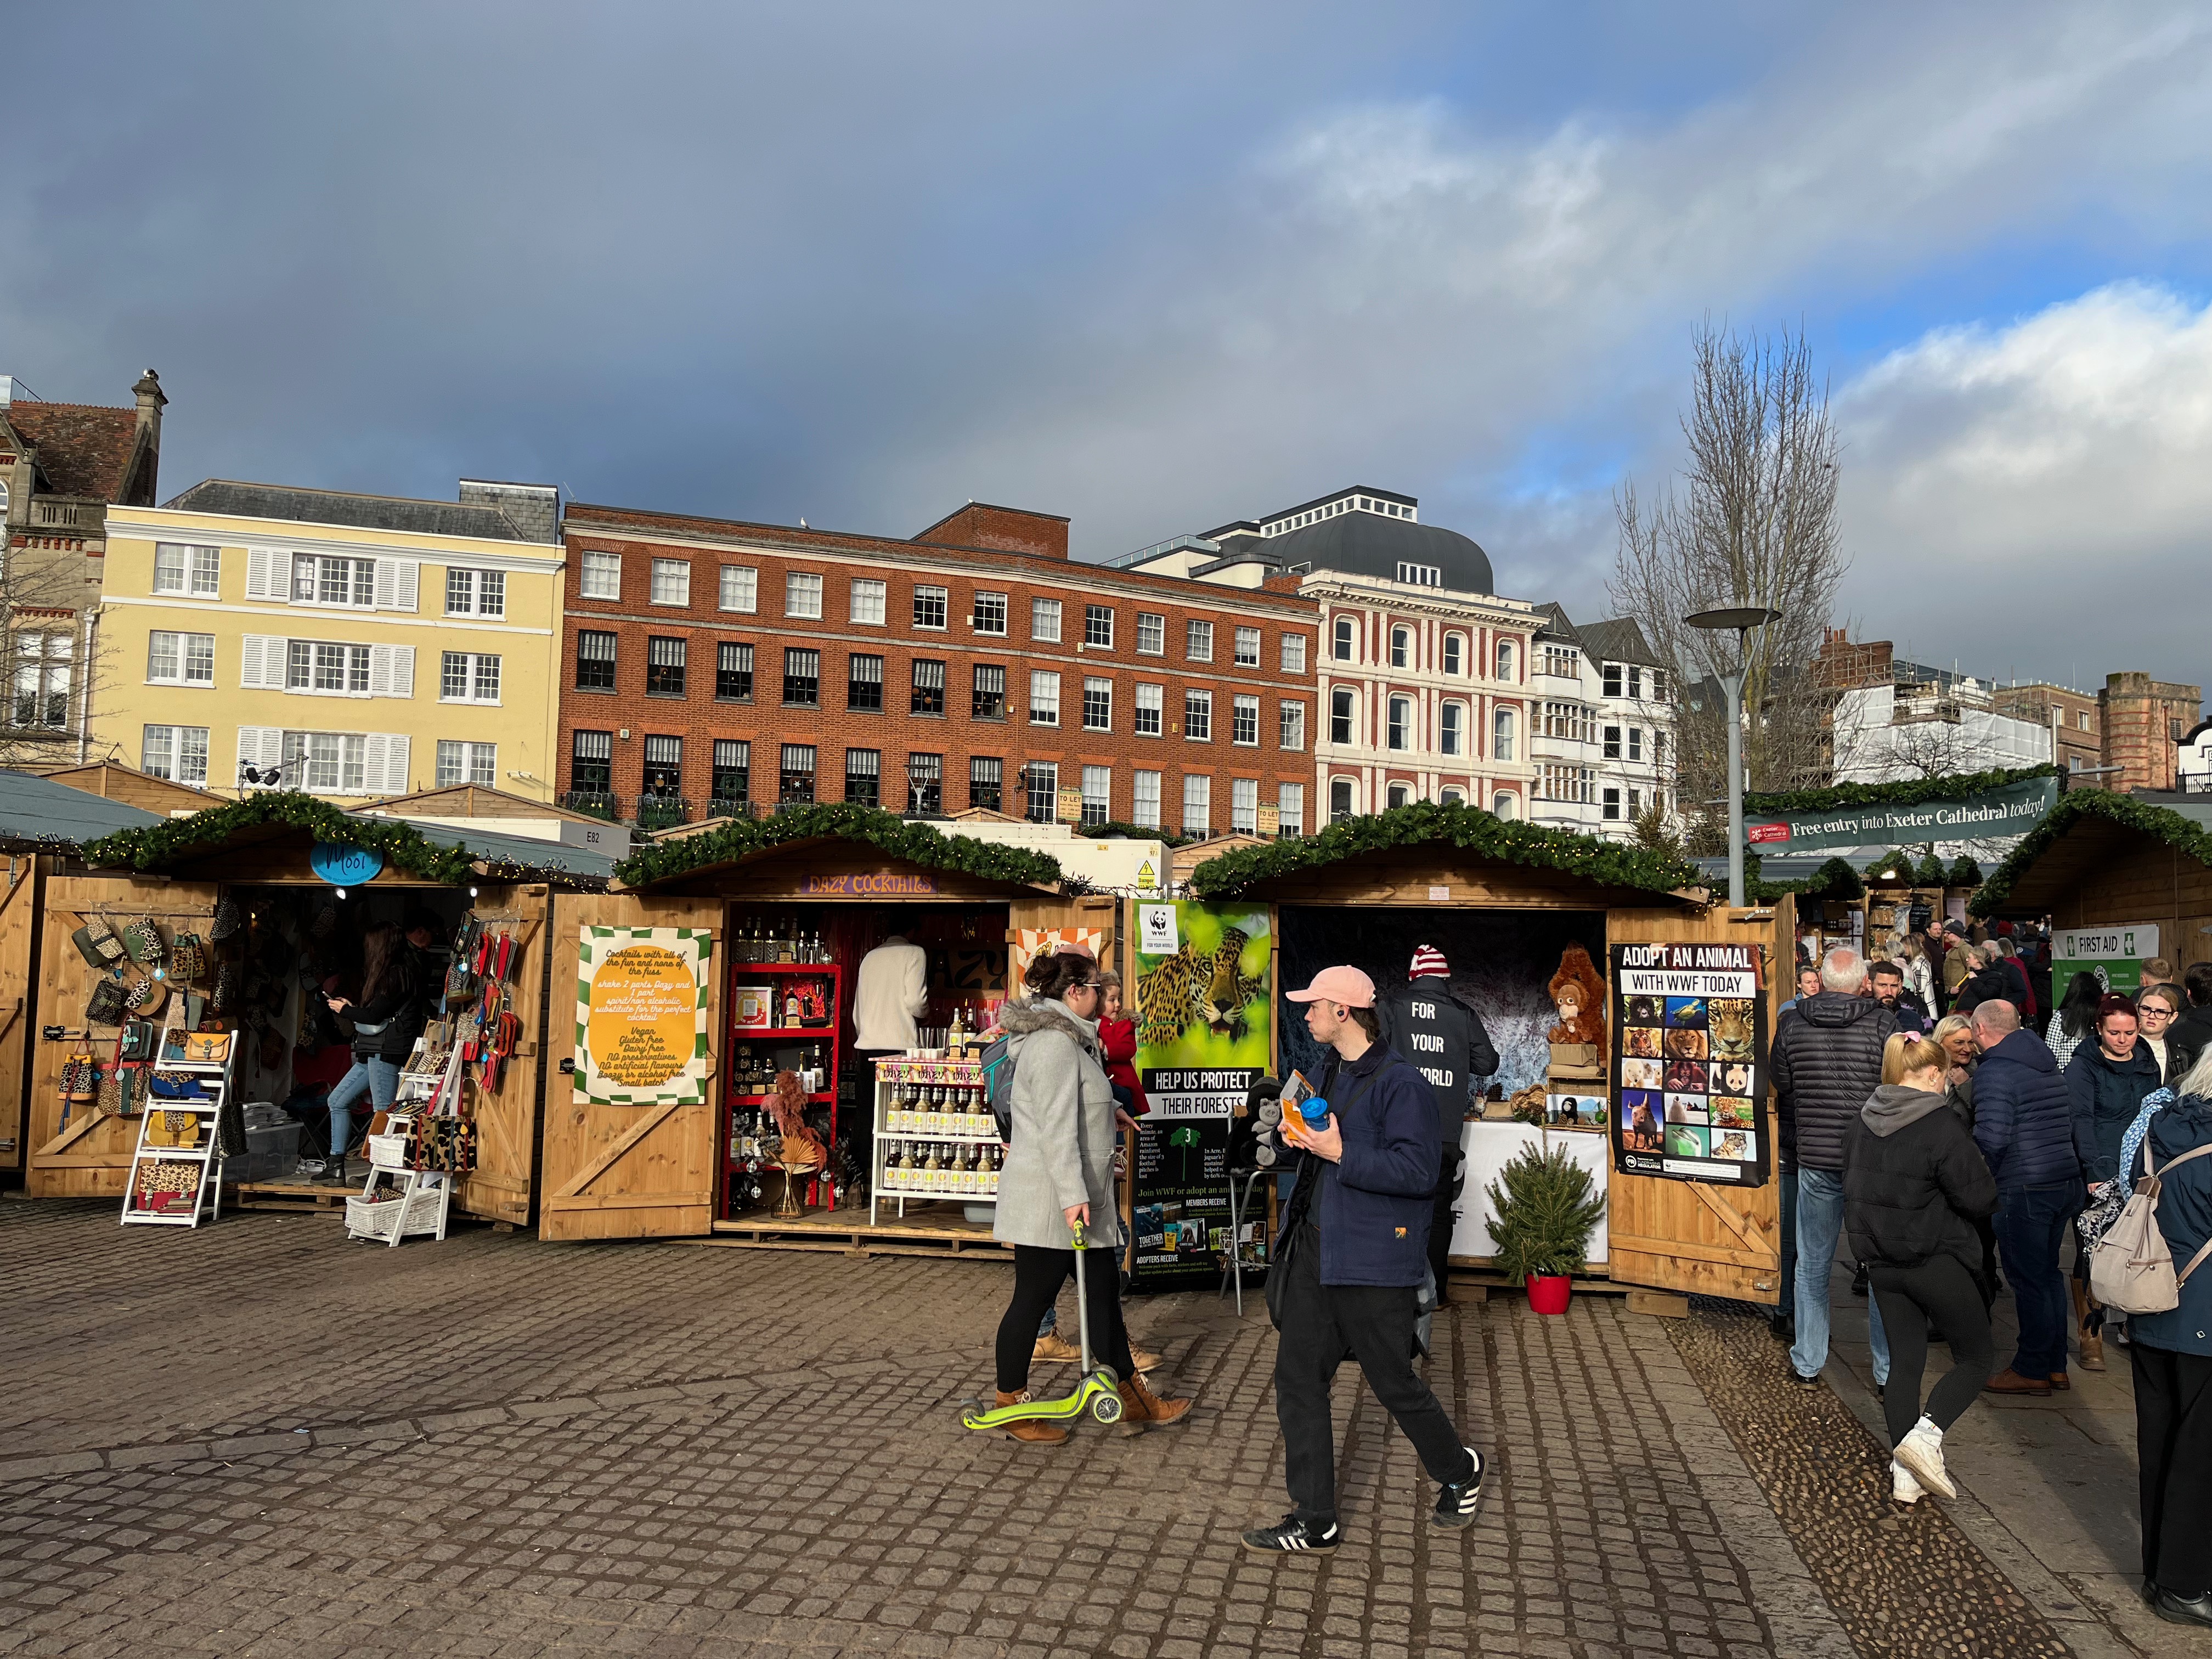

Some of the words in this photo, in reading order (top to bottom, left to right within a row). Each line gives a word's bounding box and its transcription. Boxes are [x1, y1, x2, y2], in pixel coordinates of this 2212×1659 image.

[1791, 822, 1822, 837] Free
[1824, 819, 1859, 835] entry
[1861, 815, 1884, 830] into
[1885, 812, 1933, 828] Exeter
[1936, 803, 2008, 825] Cathedral
[2010, 795, 2046, 819] today!
[587, 832, 599, 843] E82
[326, 843, 365, 876] Mool
[809, 876, 849, 893] DAZY
[853, 874, 932, 893] COCKTAILS
[2079, 936, 2101, 953] FIRST
[2103, 936, 2118, 952] AID
[606, 949, 642, 958] Cocktails
[644, 950, 662, 958] with
[663, 951, 675, 959] all
[676, 950, 687, 961] of
[1623, 947, 1669, 966] ADOPT
[1673, 947, 1692, 967] AN
[1696, 947, 1752, 968] ANIMAL
[606, 958, 619, 967] the
[620, 958, 635, 970] fun
[637, 958, 652, 967] and
[675, 959, 686, 970] of
[628, 967, 642, 975] the
[642, 967, 662, 978] fuss
[597, 980, 622, 988] shake
[630, 981, 652, 990] parts
[653, 980, 675, 991] Dazy
[1632, 974, 1663, 991] WITH
[1667, 975, 1699, 991] WWF
[1702, 976, 1742, 993] TODAY
[636, 989, 655, 998] part
[606, 997, 646, 1007] spirit/non
[647, 996, 681, 1005] alcoholic
[595, 1005, 634, 1013] substitute
[635, 1005, 649, 1015] for
[650, 1005, 663, 1013] the
[664, 1005, 692, 1015] perfect
[1412, 1002, 1436, 1019] FOR
[630, 1026, 656, 1037] Vegan
[619, 1035, 645, 1047] Gluten
[645, 1035, 665, 1046] free
[1410, 1033, 1444, 1053] YOUR
[623, 1044, 647, 1054] Dairy
[647, 1044, 665, 1055] free
[620, 1053, 678, 1063] preservatives
[613, 1060, 649, 1073] artificial
[648, 1060, 685, 1073] flavours
[596, 1070, 624, 1081] Boozy
[637, 1070, 668, 1078] alcohol
[667, 1069, 686, 1081] free
[884, 1070, 909, 1079] DAZY
[918, 1070, 944, 1079] DAZY
[953, 1071, 979, 1080] DAZY
[1155, 1072, 1181, 1090] HELP
[1183, 1071, 1198, 1090] US
[1200, 1071, 1251, 1089] PROTECT
[617, 1079, 642, 1087] Small
[1162, 1097, 1192, 1115] THEIR
[1185, 1128, 1191, 1143] 3
[1138, 1188, 1154, 1197] Join
[1156, 1187, 1176, 1196] WWF
[1186, 1186, 1206, 1196] adopt
[1218, 1185, 1243, 1194] anial
[1186, 1198, 1208, 1206] MEMBERS
[1139, 1233, 1163, 1244] TOGETHER
[1136, 1255, 1160, 1264] ADOPTERS
